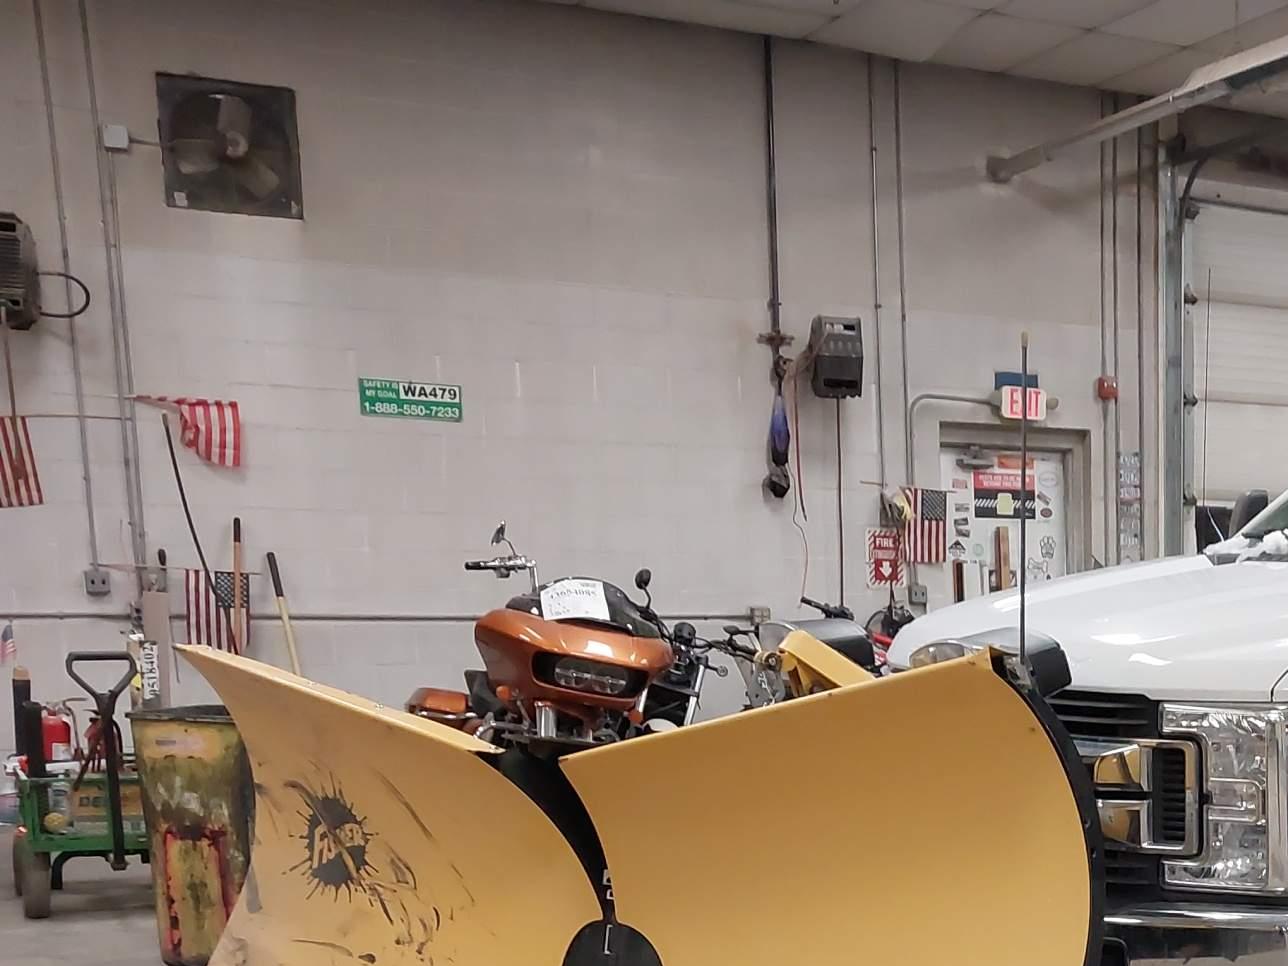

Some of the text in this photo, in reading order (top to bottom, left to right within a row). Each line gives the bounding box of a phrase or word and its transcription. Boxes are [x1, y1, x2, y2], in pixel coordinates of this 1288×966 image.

[363, 380, 390, 388] SAFETY
[365, 389, 376, 397] MY
[403, 385, 457, 400] WA479
[364, 401, 459, 418] 1-888-550-7233
[875, 537, 895, 547] FIRE
